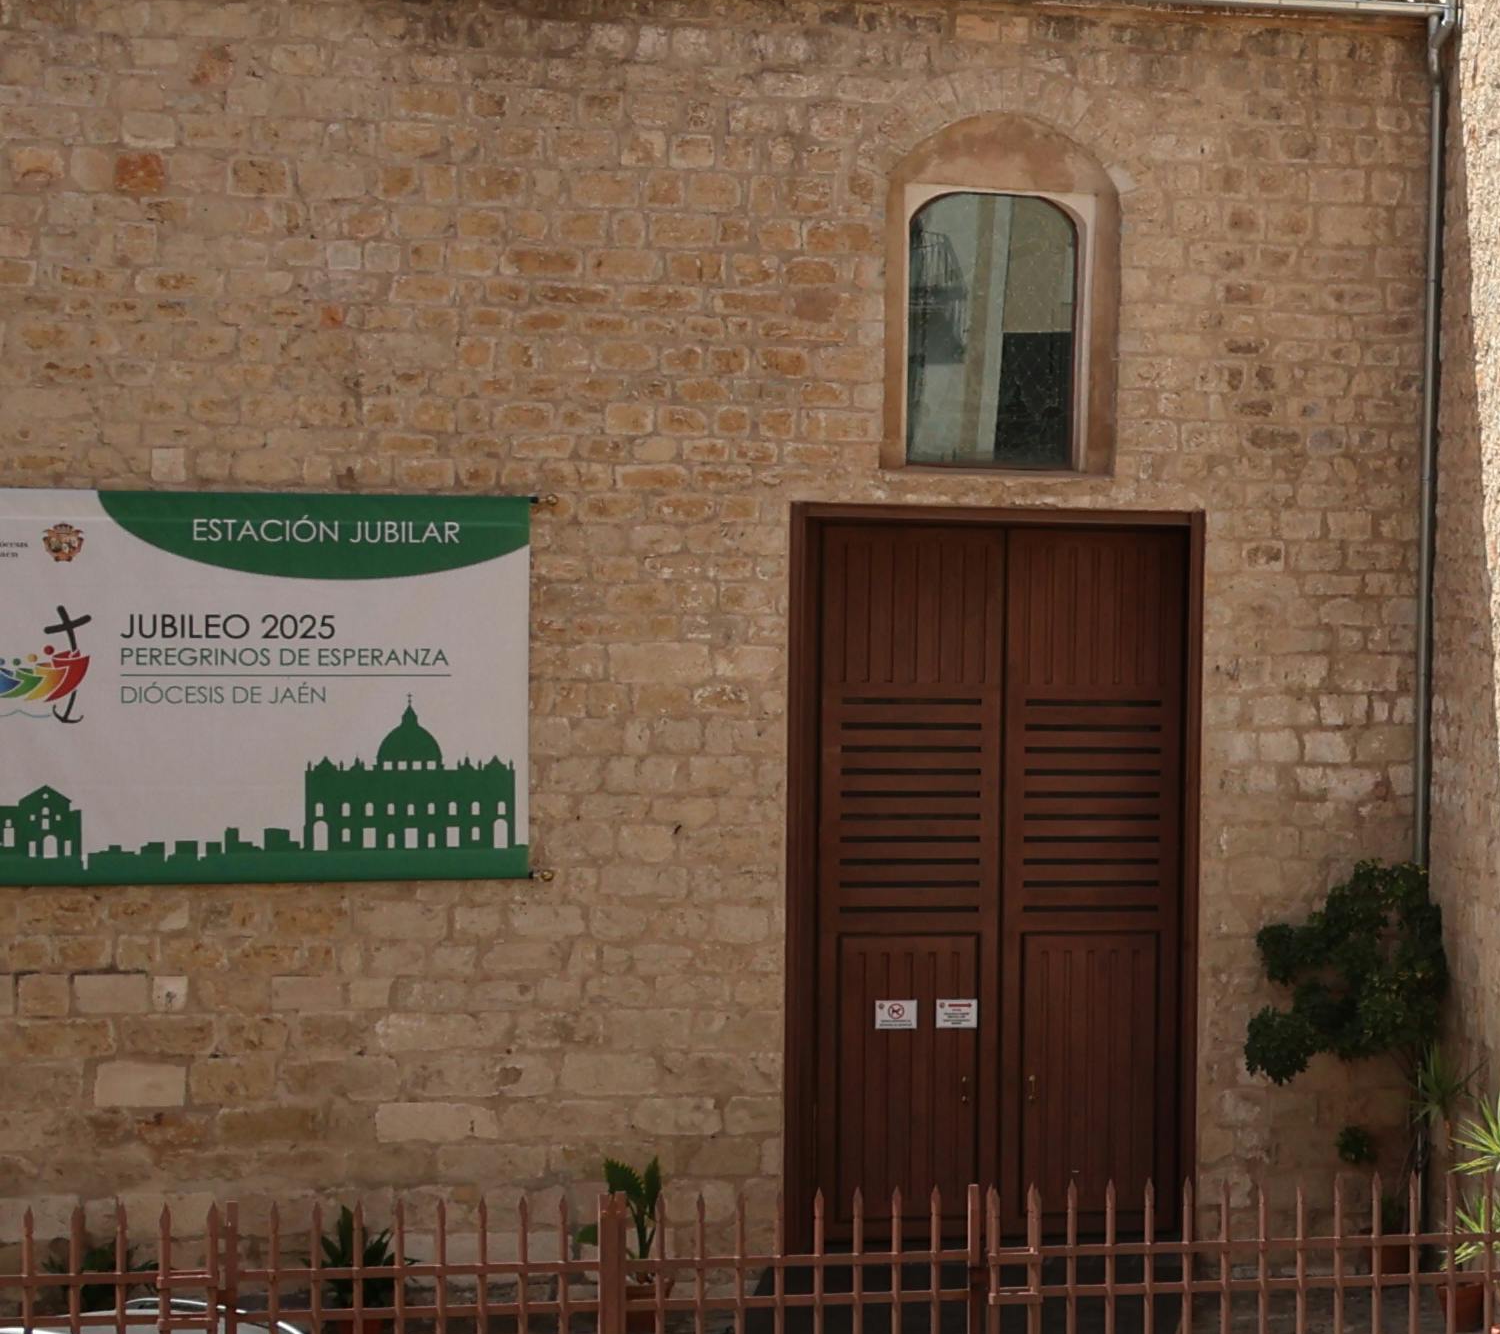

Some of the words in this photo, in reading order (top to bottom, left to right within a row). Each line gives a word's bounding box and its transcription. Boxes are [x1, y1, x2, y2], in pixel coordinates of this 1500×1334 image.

[193, 514, 339, 543] ESTACIÓN
[351, 520, 460, 544] JUBILAR
[120, 614, 250, 639] JUBILEO
[261, 614, 336, 639] 2025
[120, 647, 271, 666] PEREGRINOS
[279, 648, 311, 666] DE
[317, 648, 449, 667] ESPERANZA
[120, 682, 225, 704] DIÓCESIS
[232, 685, 262, 704] DE
[268, 681, 327, 705] JAÉN
